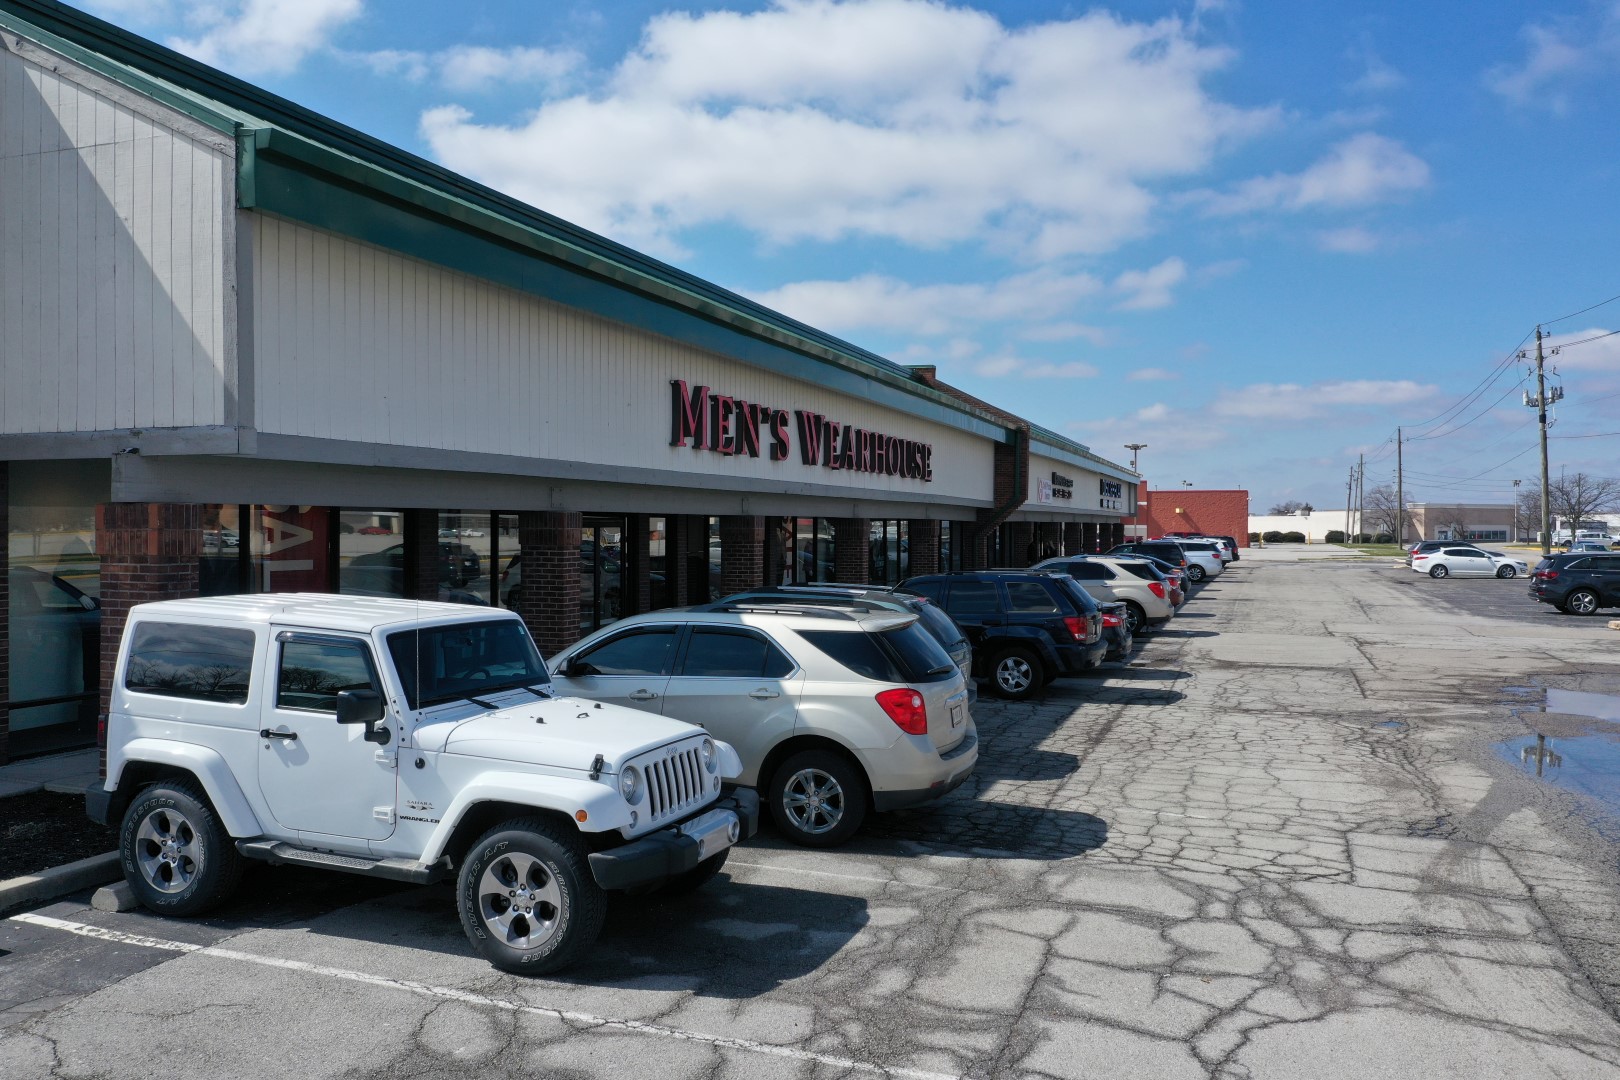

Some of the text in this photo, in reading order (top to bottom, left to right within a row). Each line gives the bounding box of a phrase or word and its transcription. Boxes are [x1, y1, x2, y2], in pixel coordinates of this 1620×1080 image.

[669, 380, 932, 482] MEN'S WEARHOUSE
[124, 798, 175, 873] BRIDGESTONE
[399, 815, 440, 824] WRANGLER
[483, 841, 509, 860] A/T
[464, 861, 487, 939] DUELER
[520, 860, 570, 963] BRIDGESTONE
